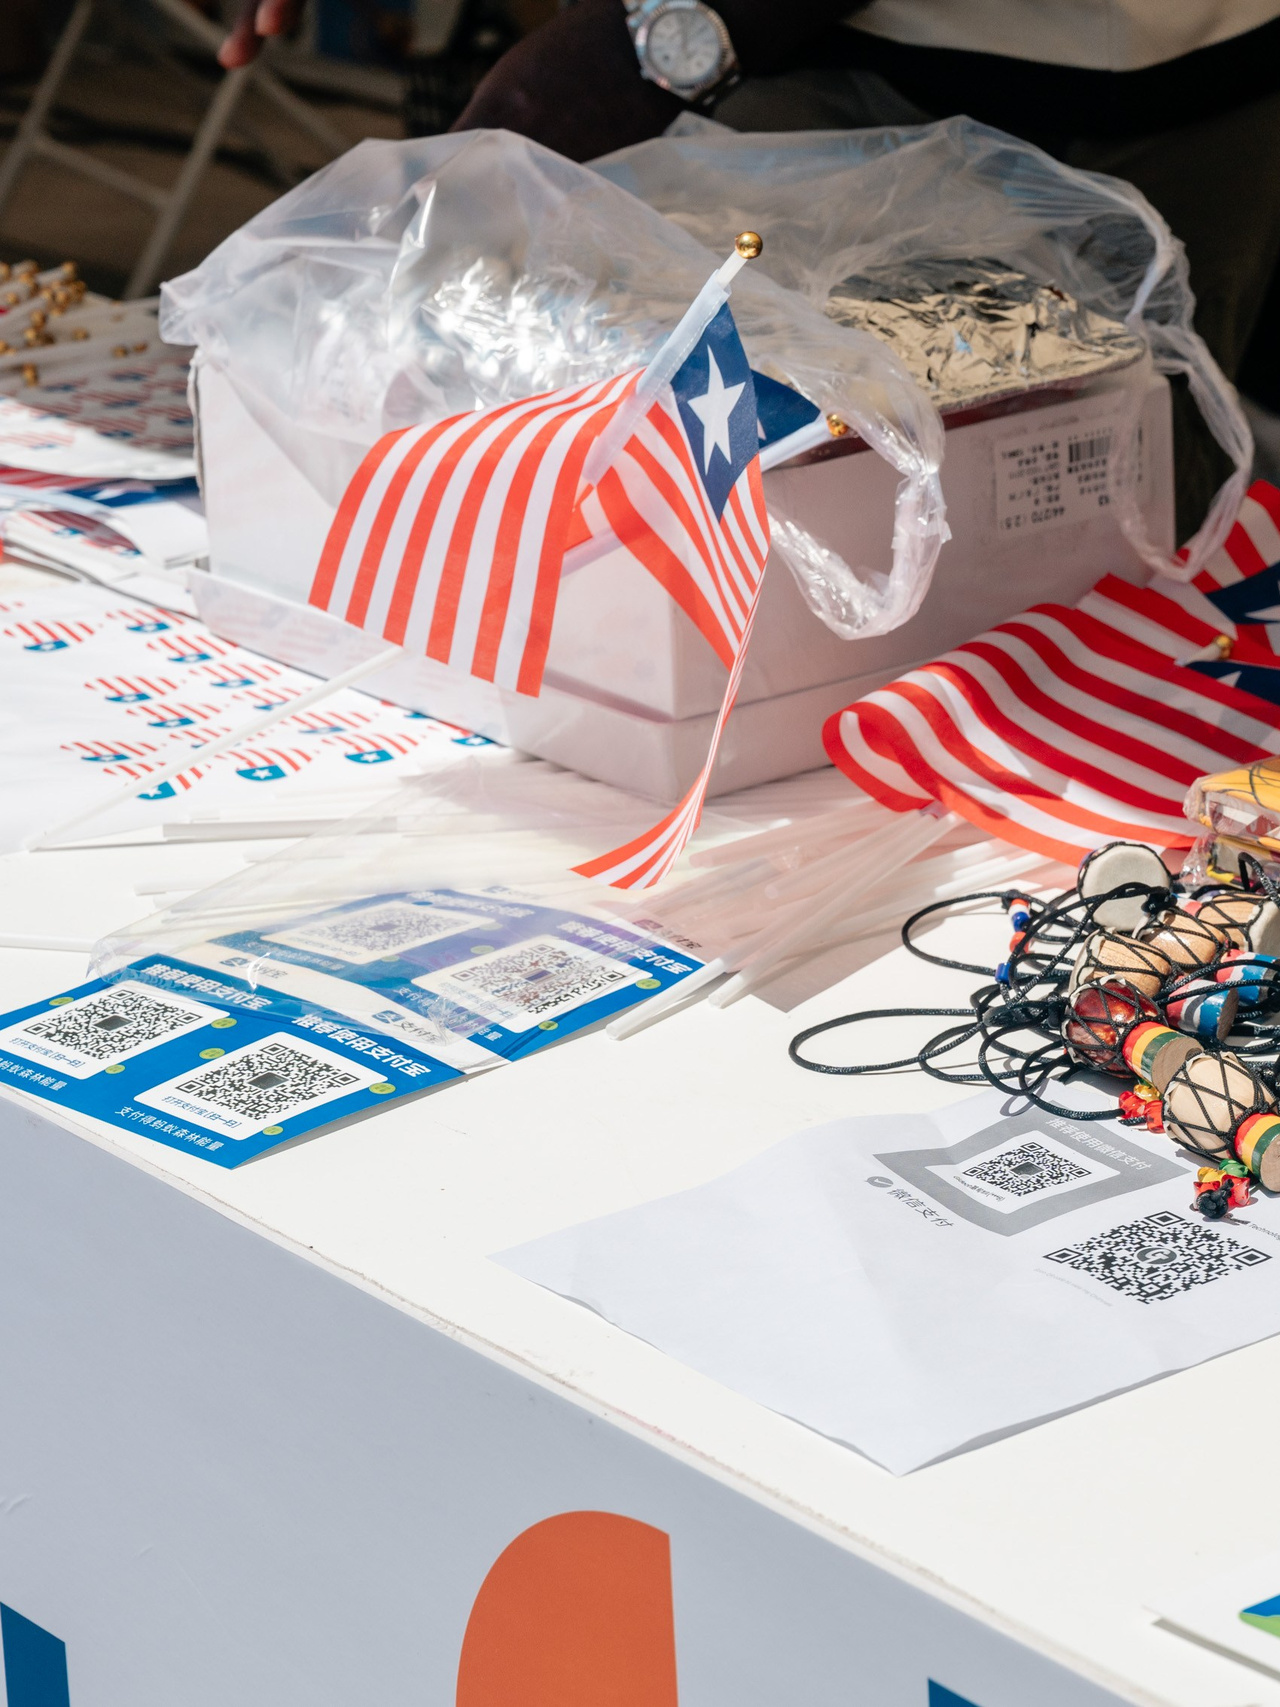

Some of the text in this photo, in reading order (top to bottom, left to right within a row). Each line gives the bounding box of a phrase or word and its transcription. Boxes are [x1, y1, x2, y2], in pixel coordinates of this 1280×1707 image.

[141, 963, 273, 1011] 推荐使用支付宝
[291, 1014, 432, 1079] 推荐使用支付宝
[114, 1106, 226, 1152] 支付得蚂蚁森林能量
[1046, 1117, 1152, 1172] 推荐使用微信支付
[886, 1187, 953, 1228] 微信支付
